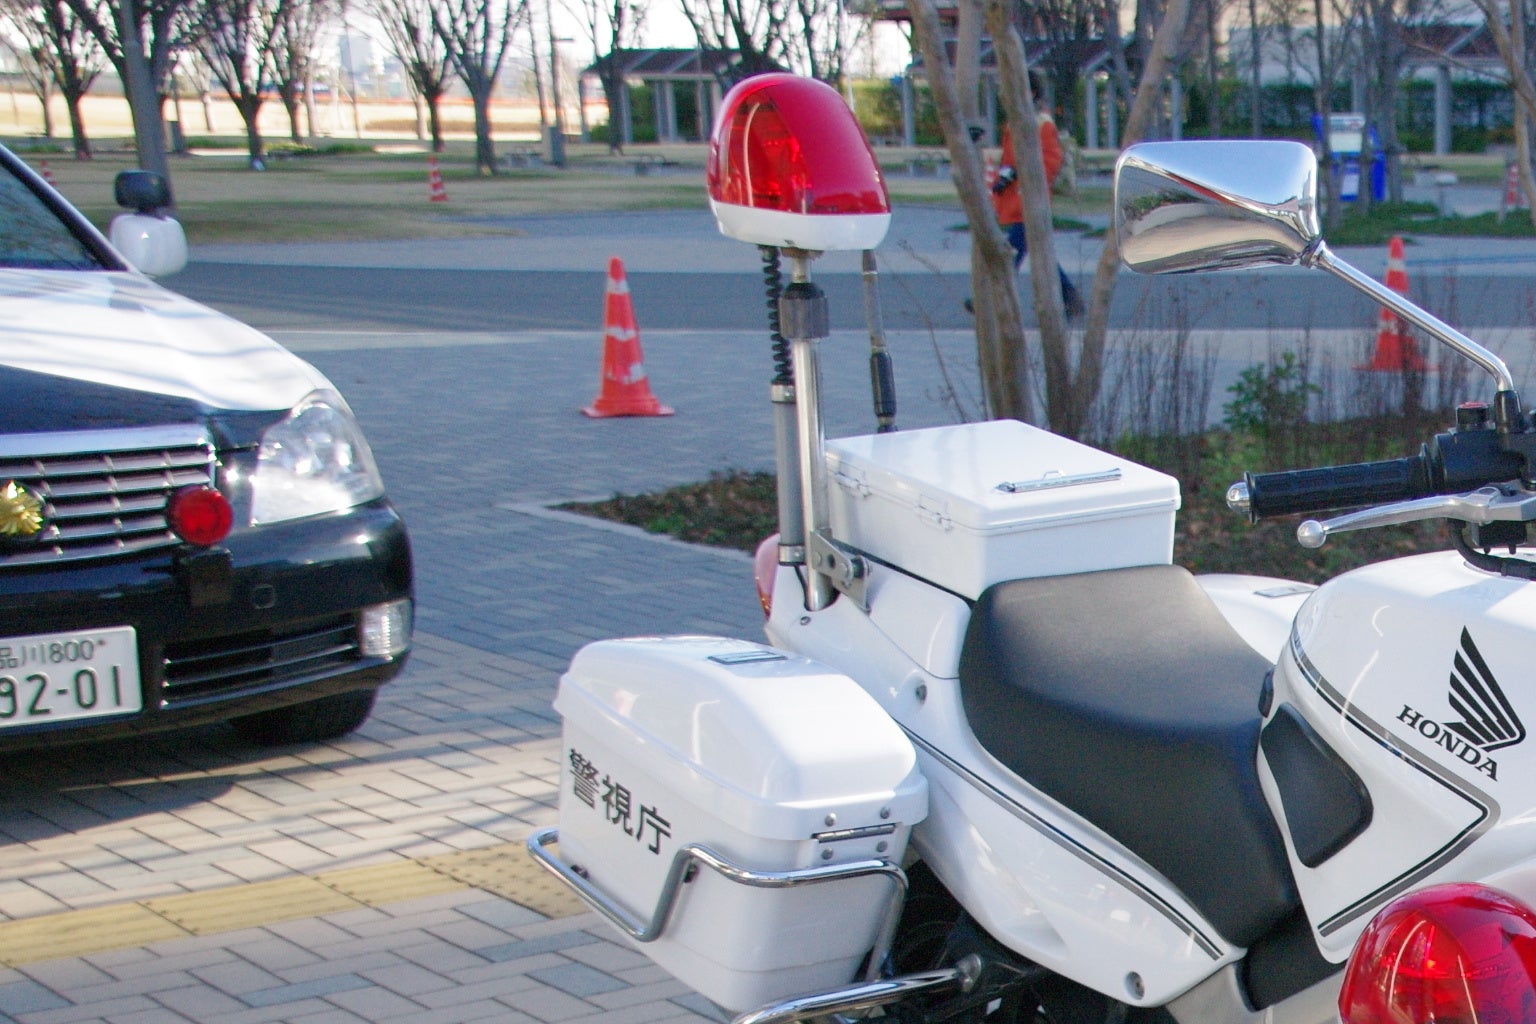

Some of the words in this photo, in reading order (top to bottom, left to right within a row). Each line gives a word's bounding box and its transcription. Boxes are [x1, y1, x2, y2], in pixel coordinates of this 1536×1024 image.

[1396, 704, 1499, 782] HONDA
[569, 748, 672, 855] 警視庁
